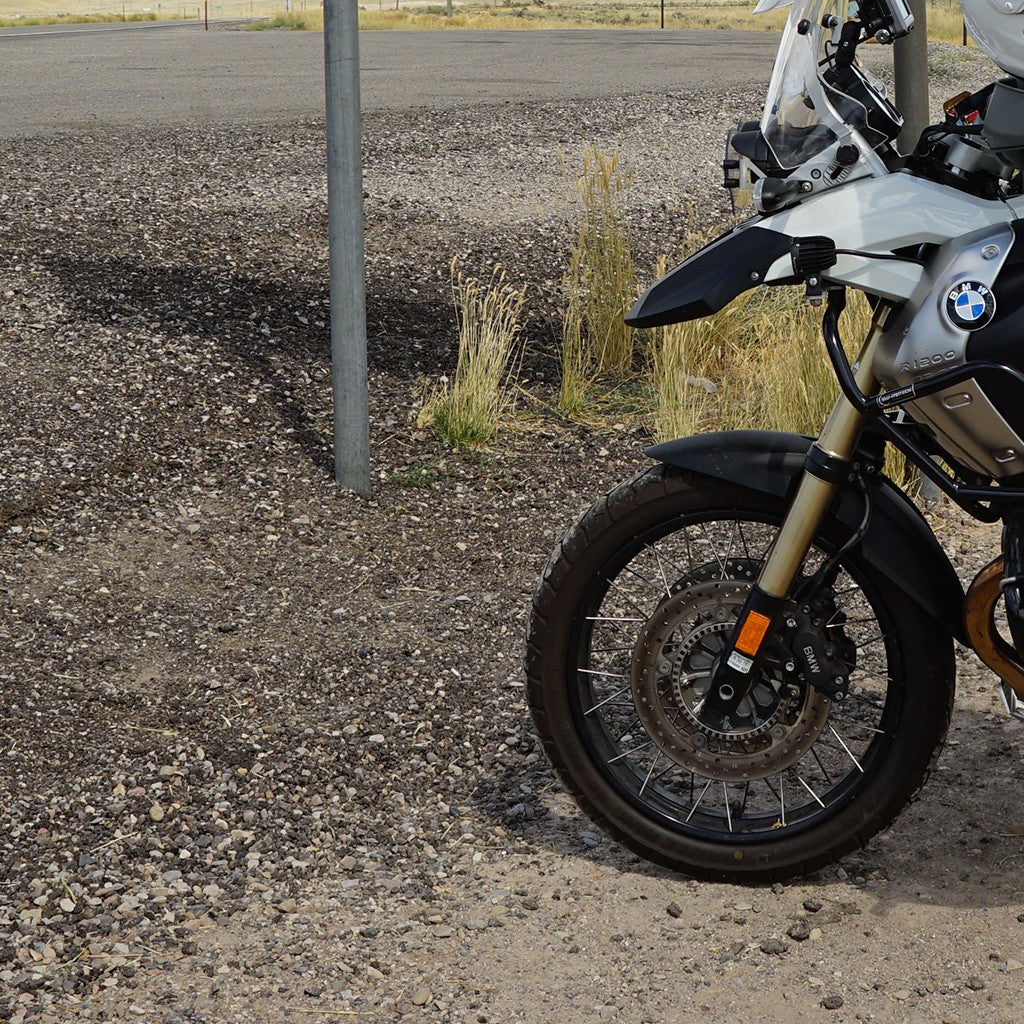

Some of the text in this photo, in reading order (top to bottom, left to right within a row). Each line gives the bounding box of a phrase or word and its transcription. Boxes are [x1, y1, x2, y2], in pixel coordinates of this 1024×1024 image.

[949, 282, 989, 301] BMW
[900, 350, 956, 372] R1200
[803, 645, 821, 674] BMW
